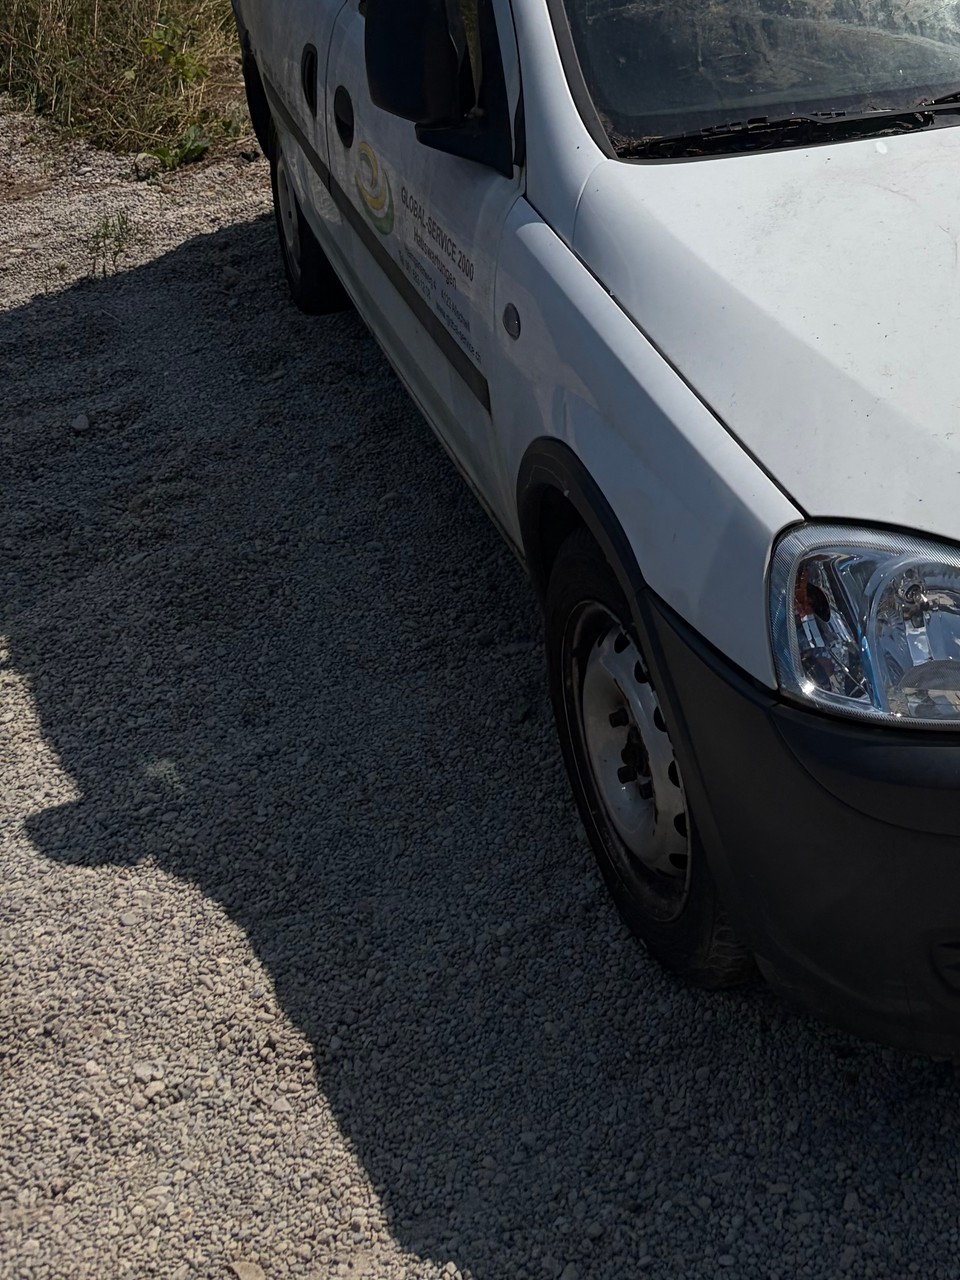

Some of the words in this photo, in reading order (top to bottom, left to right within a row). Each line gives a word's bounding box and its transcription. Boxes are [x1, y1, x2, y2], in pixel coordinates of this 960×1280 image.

[401, 186, 457, 264] GLOBAL-SERVICE
[457, 250, 474, 283] 2000
[413, 226, 457, 291] Hauswartungen
